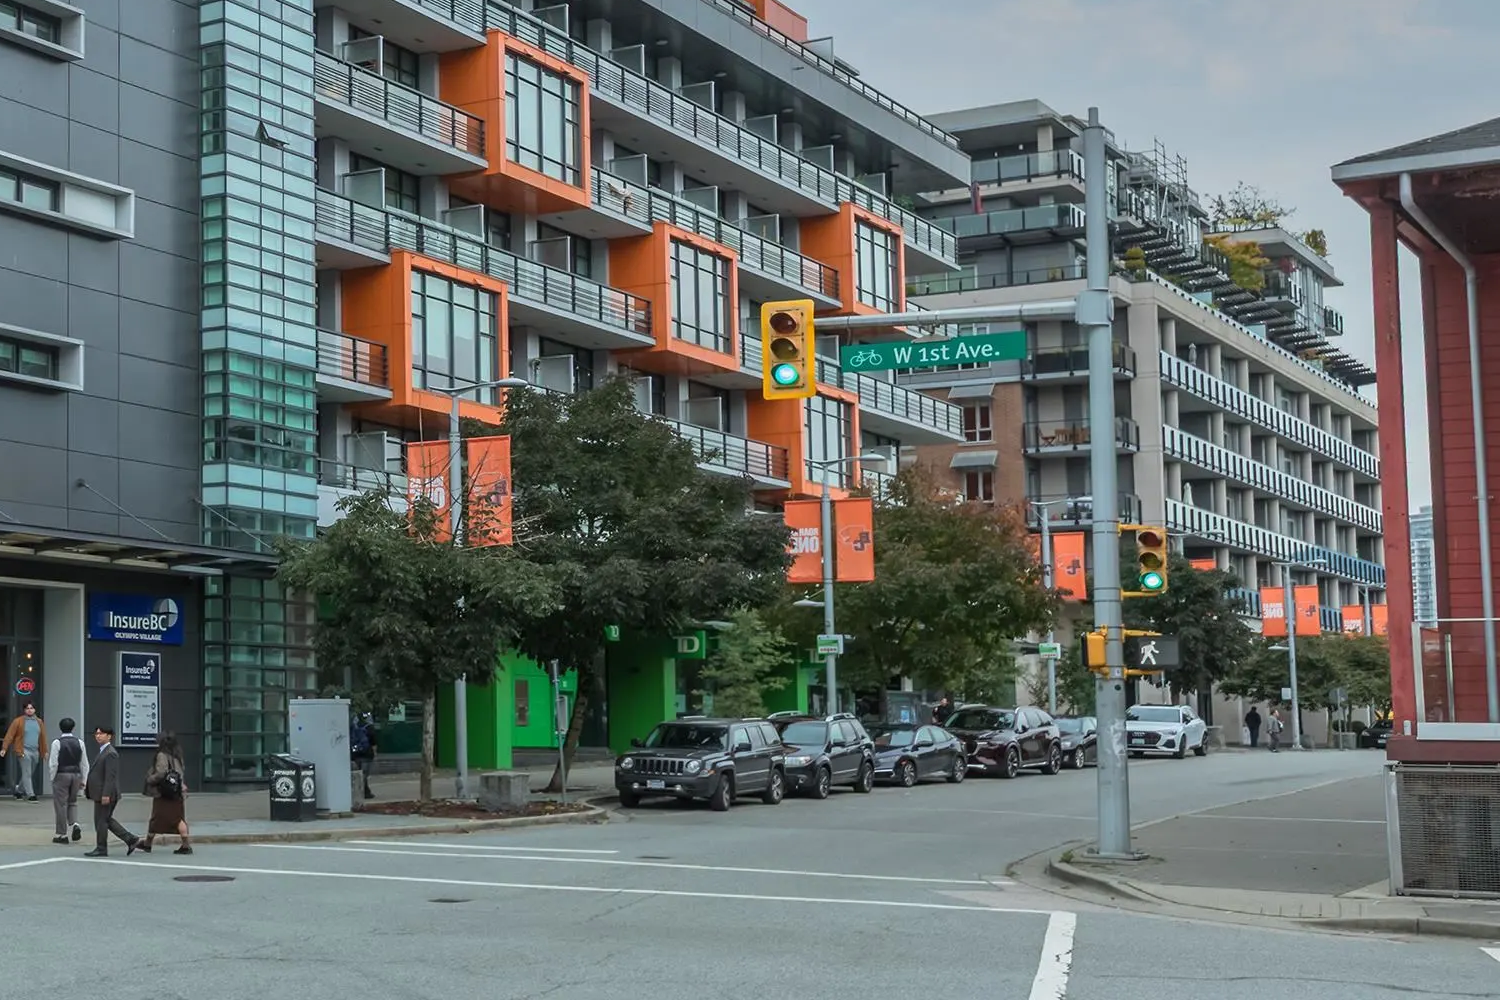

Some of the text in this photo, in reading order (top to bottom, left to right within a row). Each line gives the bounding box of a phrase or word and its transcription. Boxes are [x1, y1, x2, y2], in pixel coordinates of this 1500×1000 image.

[893, 342, 1000, 364] W 1st Ave.
[109, 611, 167, 631] InsureBC
[114, 631, 162, 641] OLYMPIC VILLAGE
[672, 635, 700, 653] TD
[125, 665, 151, 675] InsureBC
